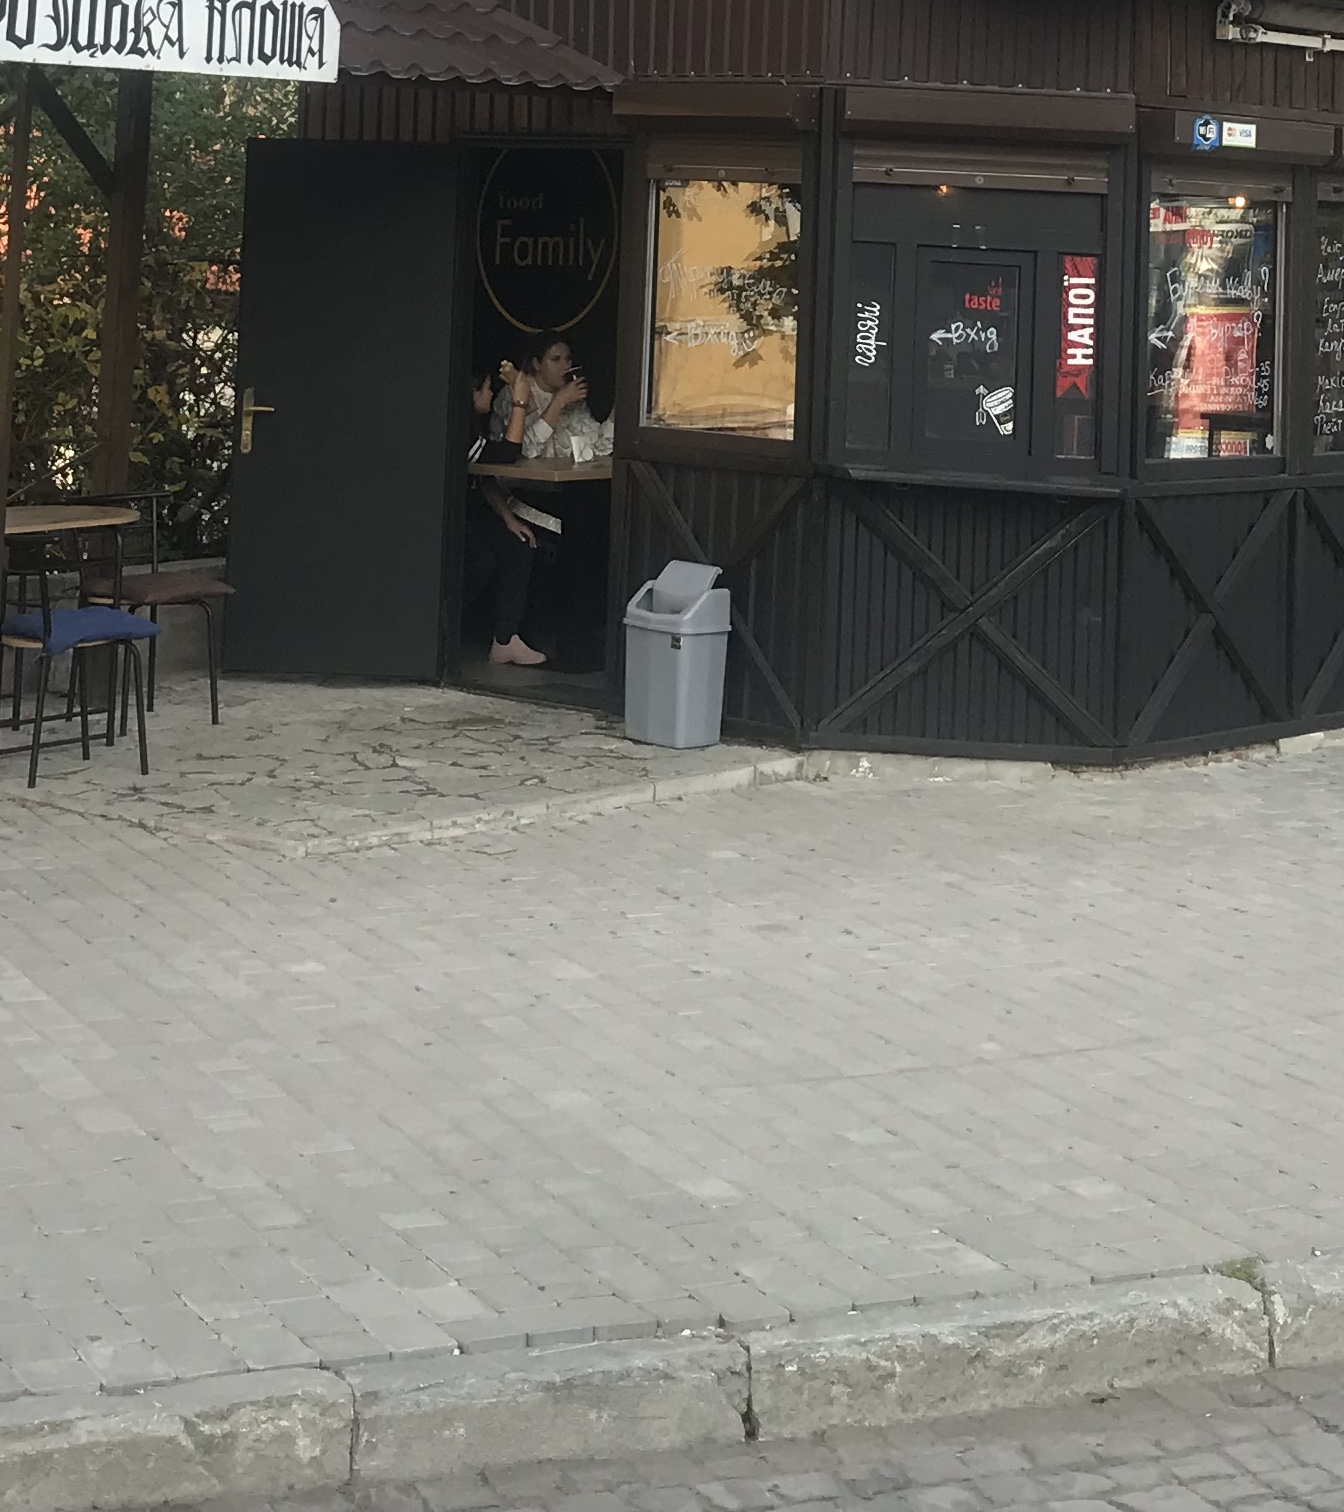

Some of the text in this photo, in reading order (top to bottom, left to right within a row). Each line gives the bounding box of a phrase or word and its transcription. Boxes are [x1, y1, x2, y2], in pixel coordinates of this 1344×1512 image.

[499, 191, 544, 210] food
[494, 217, 605, 281] Family
[964, 292, 1001, 311] taste
[1063, 274, 1096, 365] НАПОЇ
[951, 321, 999, 353] Вхід
